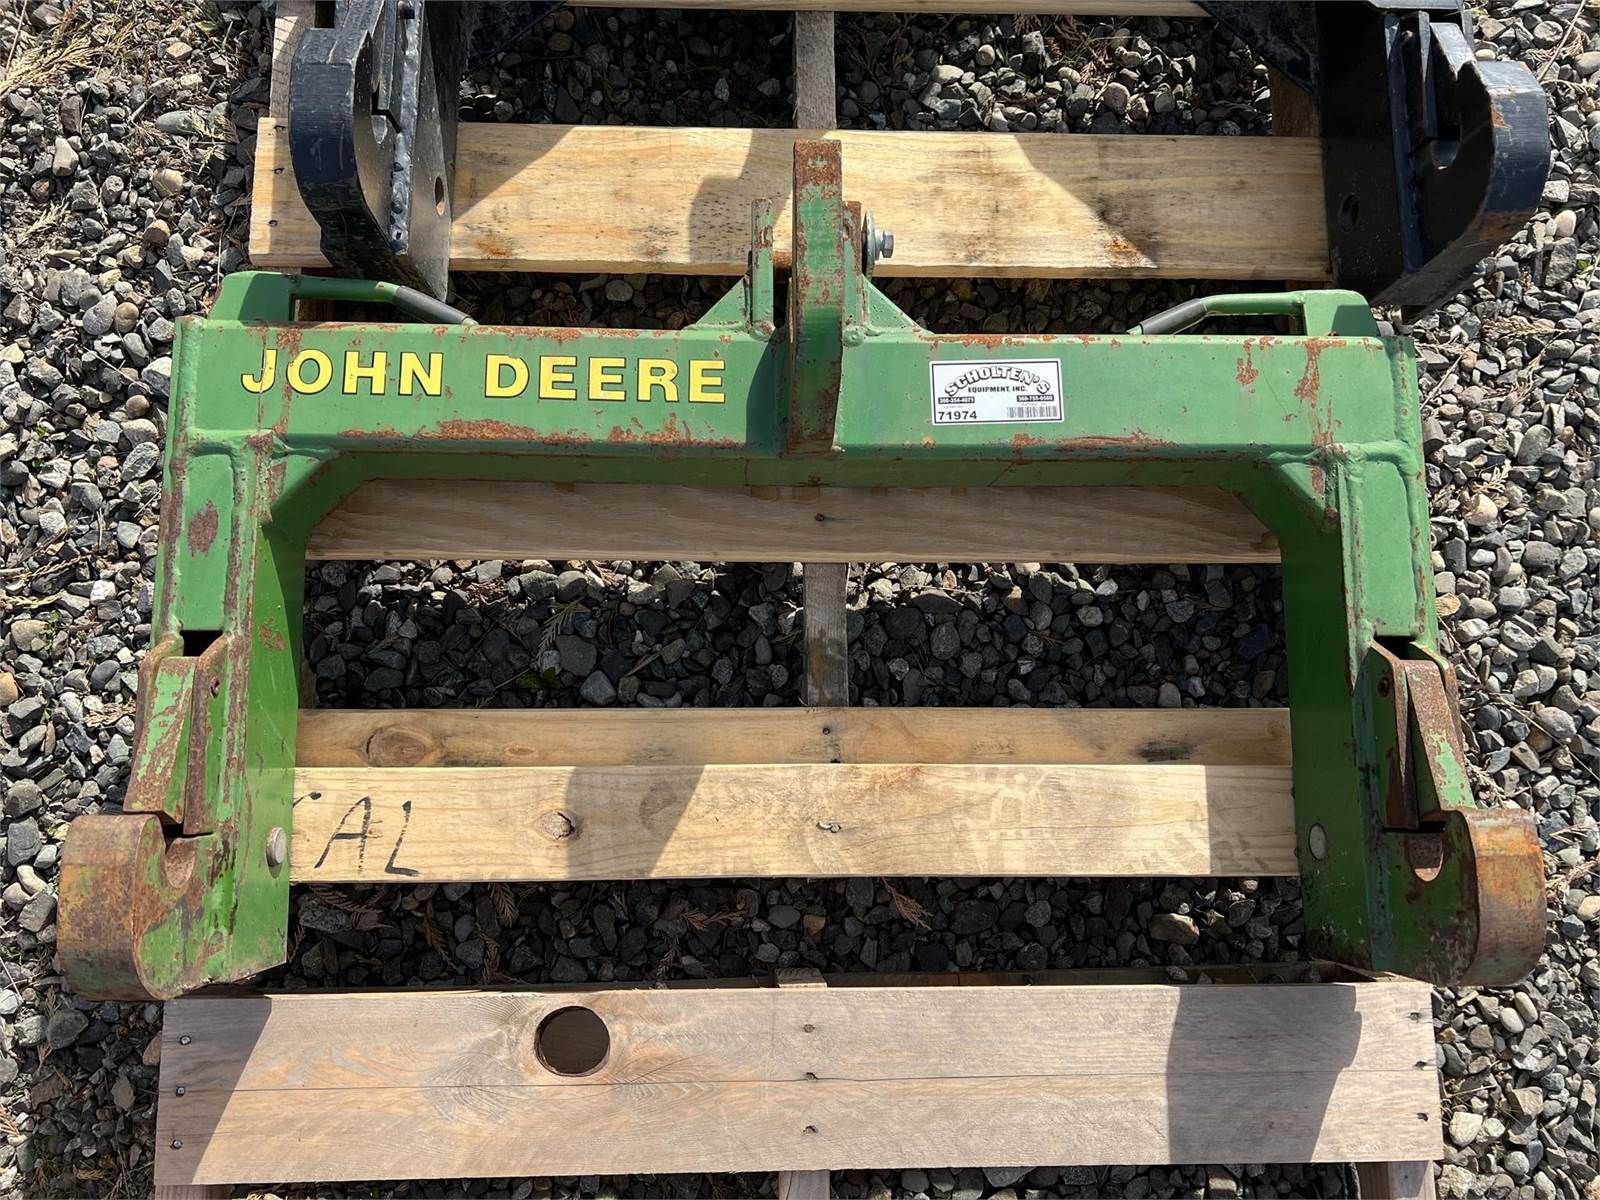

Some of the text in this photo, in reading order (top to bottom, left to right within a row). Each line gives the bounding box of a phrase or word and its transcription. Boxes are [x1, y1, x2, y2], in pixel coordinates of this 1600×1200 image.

[241, 348, 727, 404] JOHN DEERE
[944, 365, 1051, 396] SCHOLTEN'S
[938, 411, 977, 420] 71974
